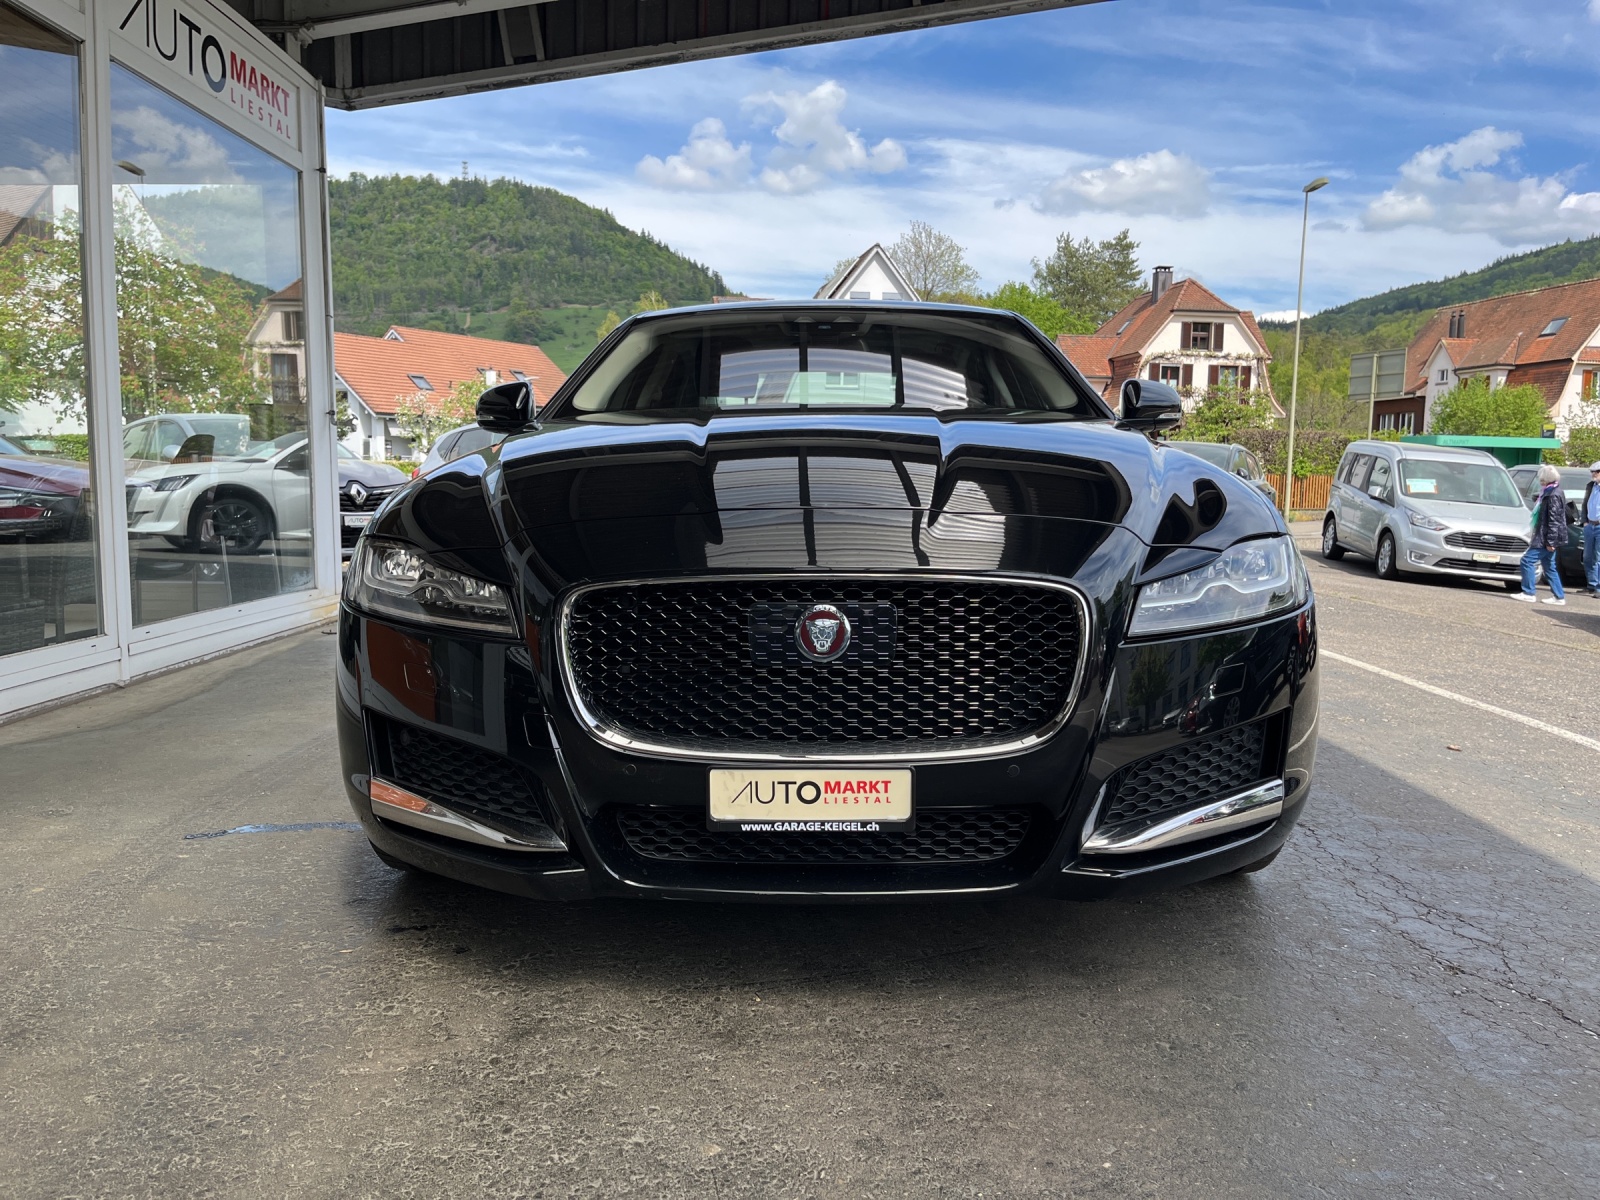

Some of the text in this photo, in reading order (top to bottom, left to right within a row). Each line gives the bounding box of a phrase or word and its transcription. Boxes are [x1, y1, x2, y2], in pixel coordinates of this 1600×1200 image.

[230, 50, 290, 117] MARKT
[230, 87, 291, 140] LIESTAL
[731, 780, 892, 804] AUTO MARKT
[740, 821, 880, 832] www.GARAGE-KEIGEL.ch
